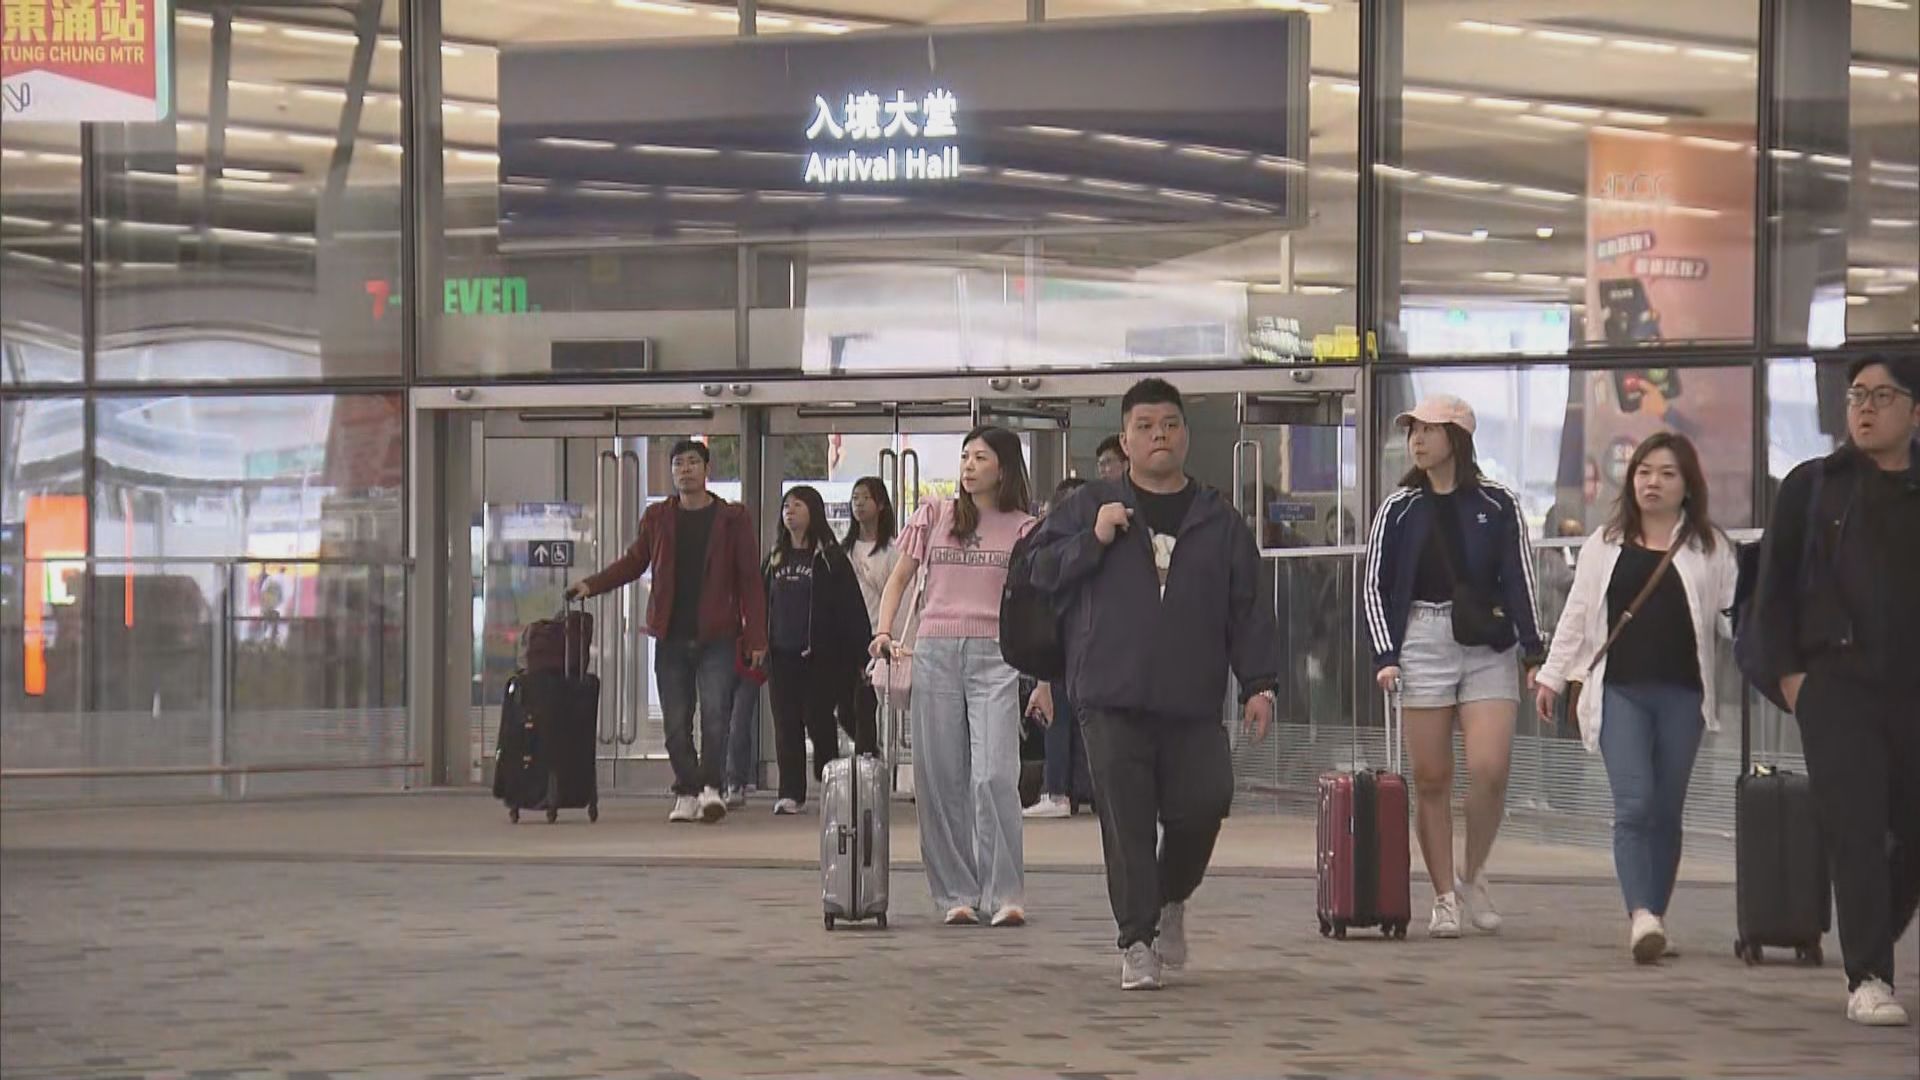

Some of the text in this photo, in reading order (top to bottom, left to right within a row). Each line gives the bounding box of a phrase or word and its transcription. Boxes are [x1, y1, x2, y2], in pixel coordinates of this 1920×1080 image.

[2, 0, 144, 42] 東涌站
[1, 45, 144, 63] TUNG CHUNG MTR
[806, 87, 957, 140] 入境大堂
[804, 145, 958, 183] Arrival Hall
